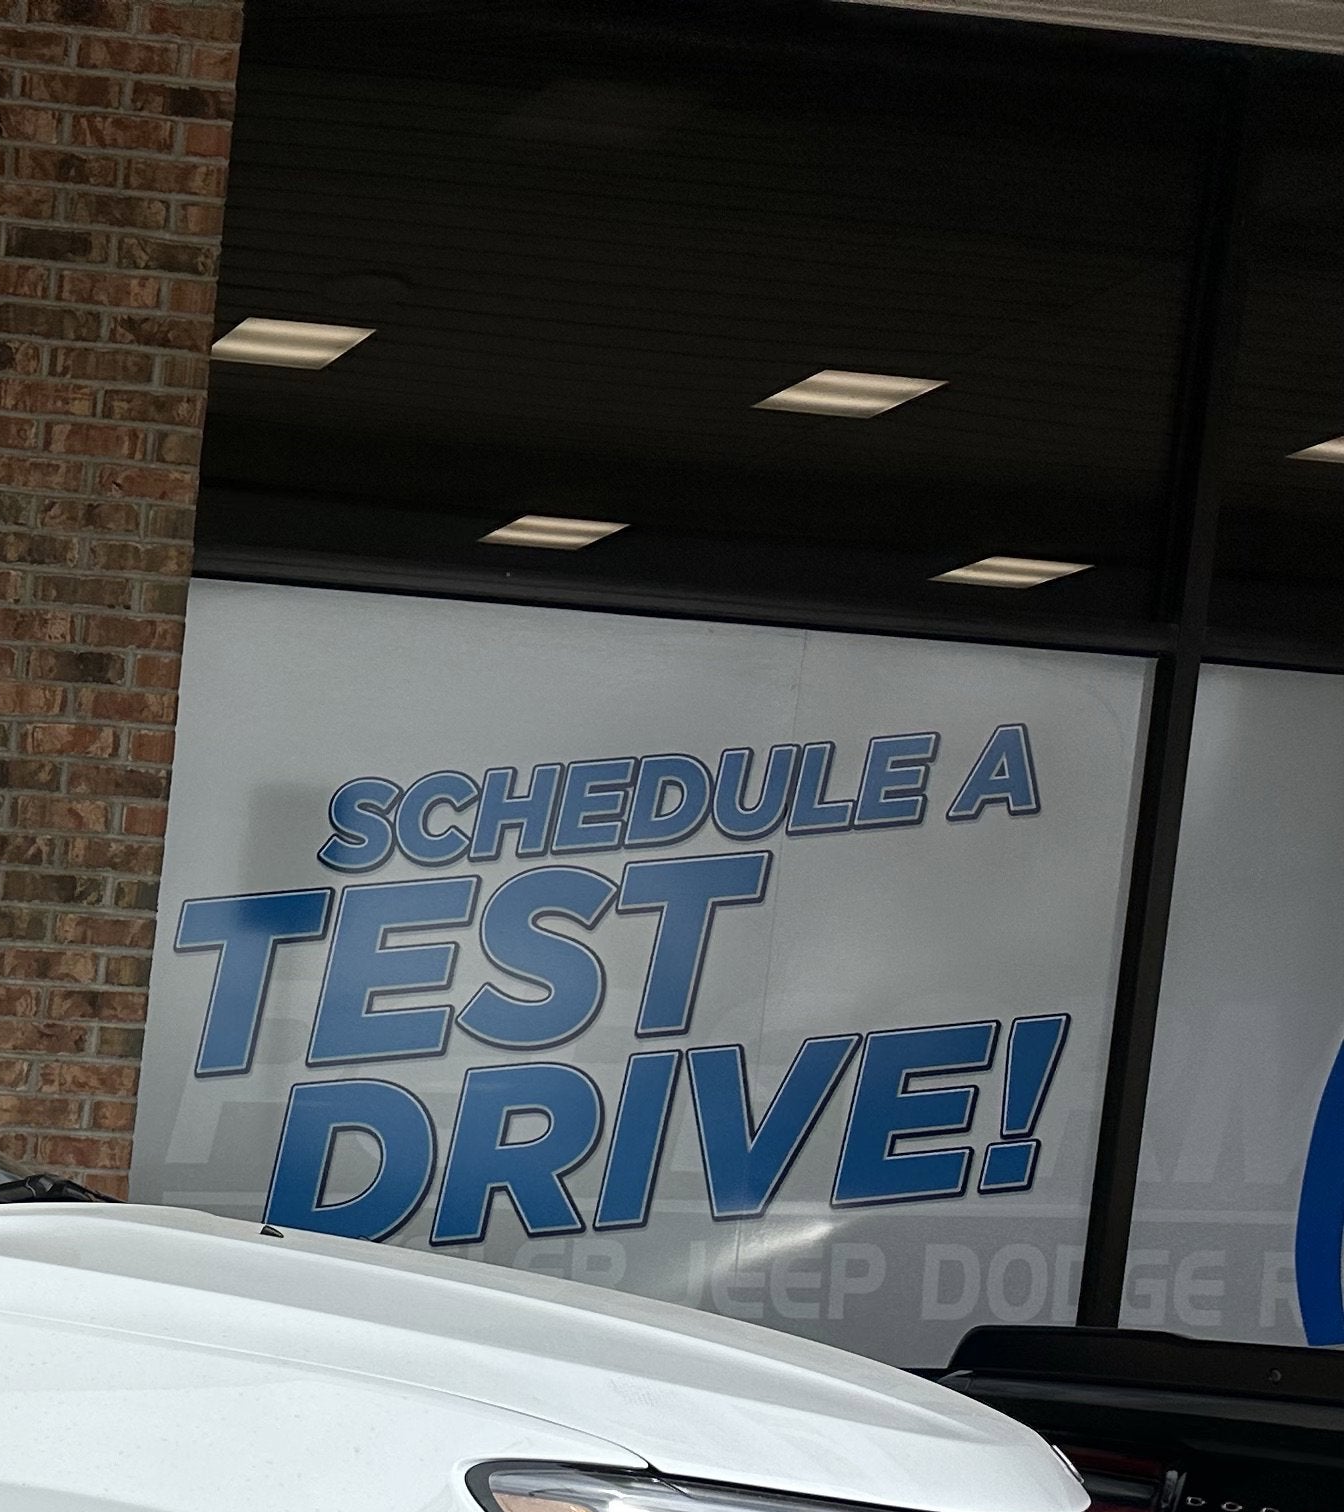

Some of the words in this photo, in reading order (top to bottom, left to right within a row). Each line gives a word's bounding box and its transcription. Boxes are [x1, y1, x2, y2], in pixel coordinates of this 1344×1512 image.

[318, 730, 940, 871] SCHEDULE
[947, 723, 1041, 822] A
[174, 850, 774, 1079] TEST
[262, 1013, 1072, 1246] DRIVE!
[674, 1240, 887, 1319] JEEP
